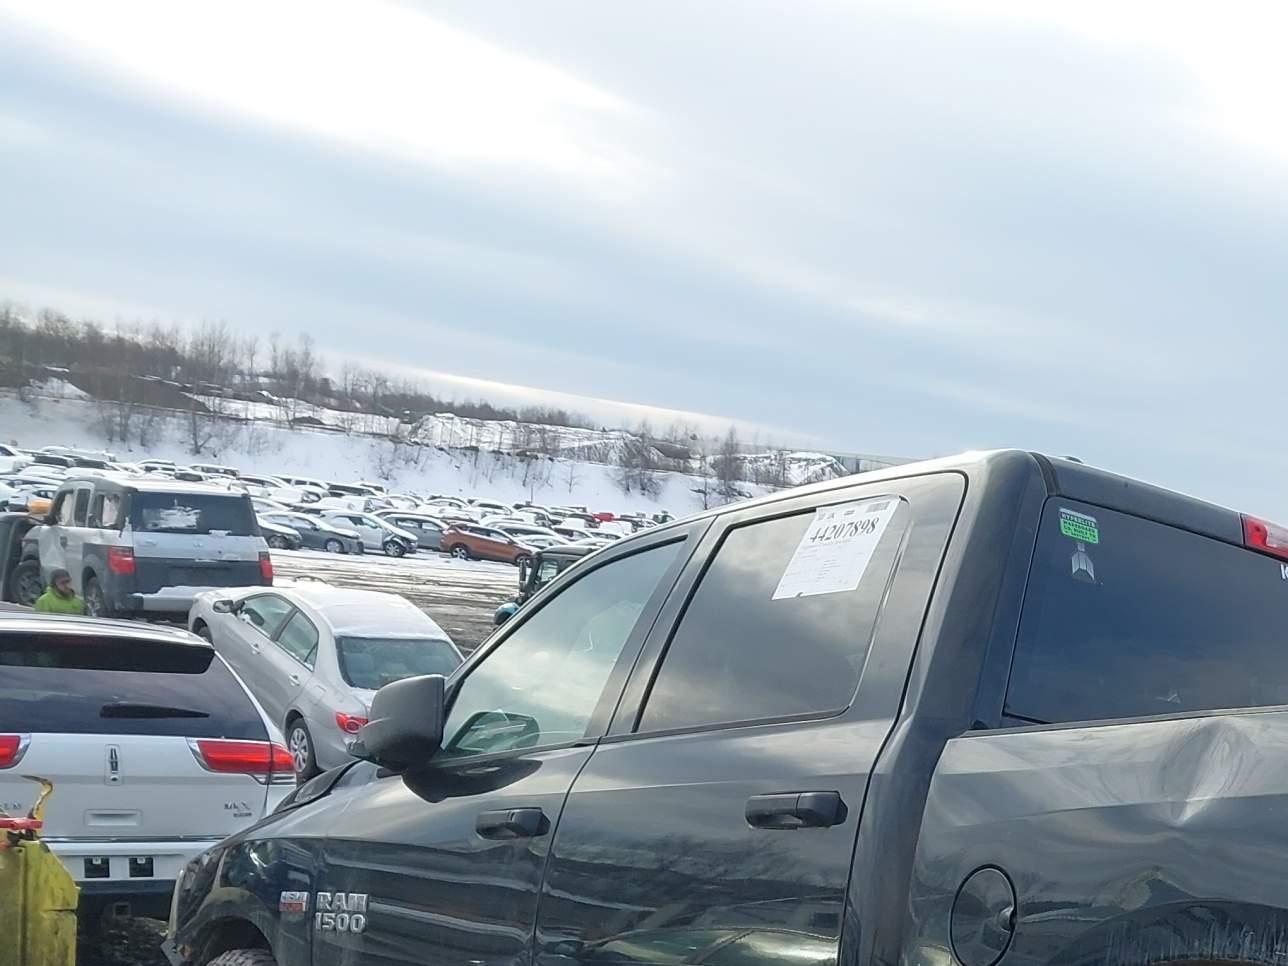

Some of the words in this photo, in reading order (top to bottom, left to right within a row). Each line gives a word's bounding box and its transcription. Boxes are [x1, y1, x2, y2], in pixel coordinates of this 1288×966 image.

[810, 516, 880, 544] 44207898
[316, 891, 368, 913] RAM
[315, 912, 367, 934] 1500
